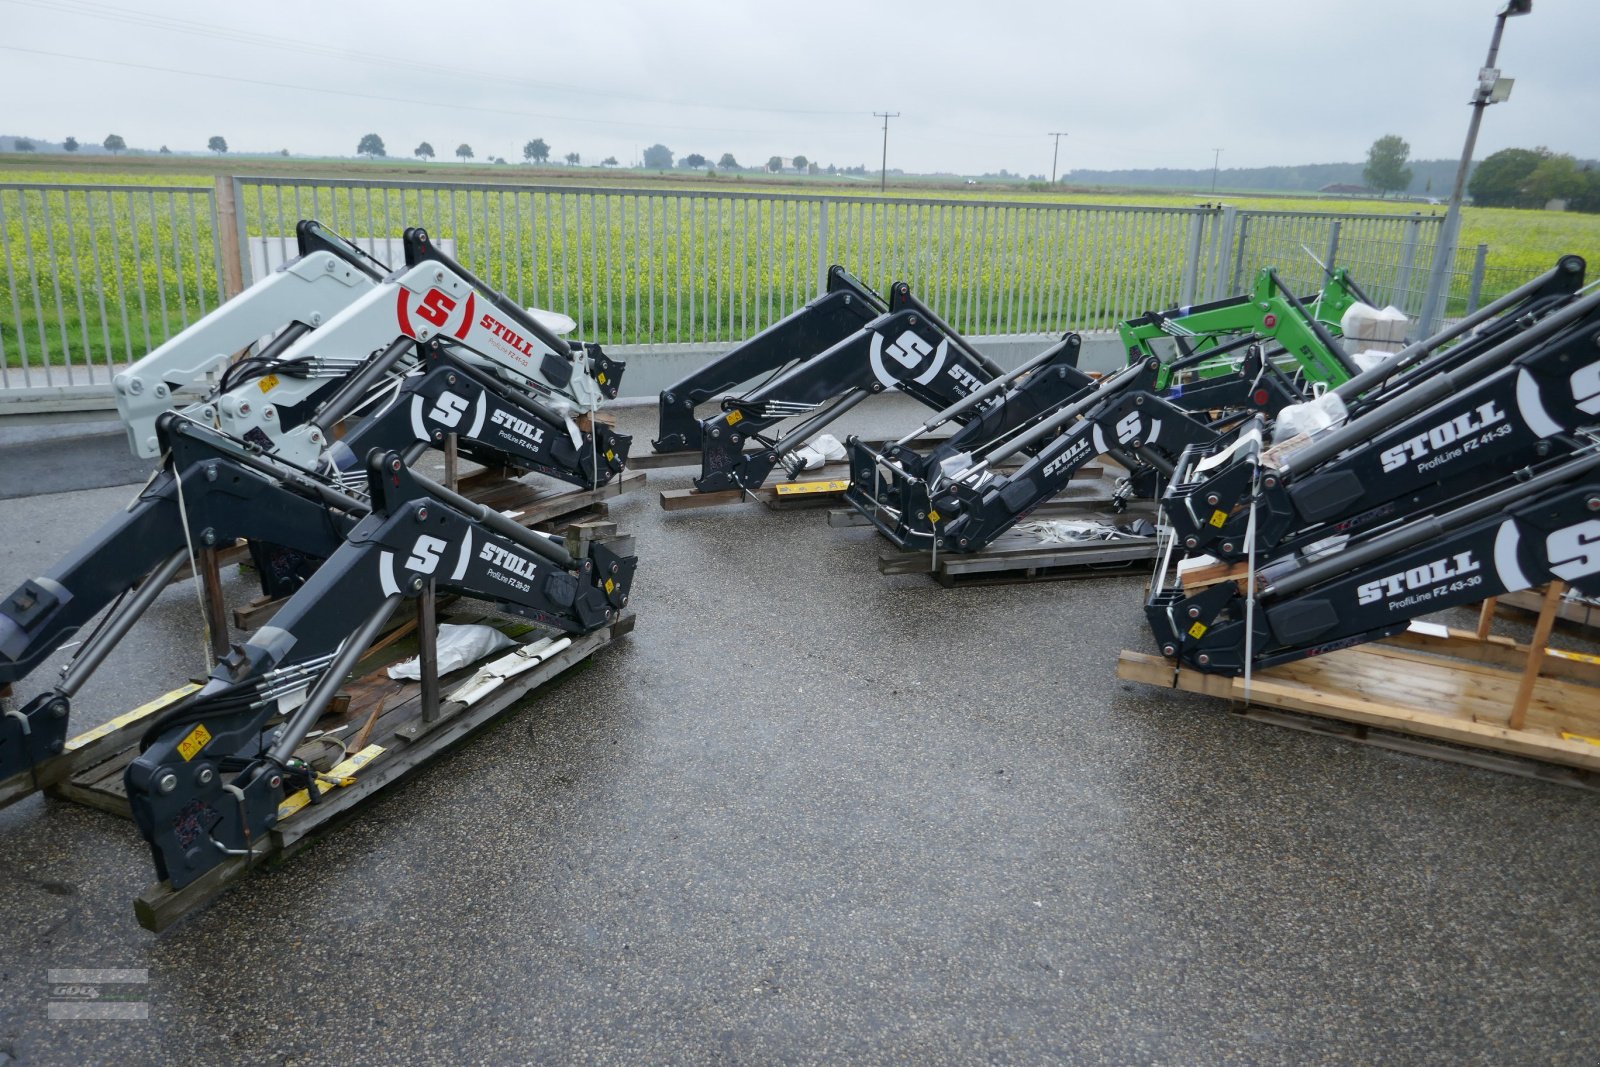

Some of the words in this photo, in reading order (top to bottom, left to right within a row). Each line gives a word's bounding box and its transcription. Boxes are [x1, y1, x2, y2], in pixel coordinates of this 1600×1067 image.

[415, 288, 457, 328] S
[479, 313, 534, 358] STOLL
[507, 350, 516, 359] FZ
[885, 330, 934, 369] S
[428, 390, 470, 428] S
[491, 408, 545, 444] STOLL
[518, 439, 527, 447] FZ
[1380, 400, 1506, 474] STOLL
[1417, 448, 1462, 474] ProfiLine
[1462, 437, 1480, 453] FZ
[1480, 423, 1513, 444] 41-33
[1042, 437, 1089, 478] STOLL
[404, 534, 448, 575] S
[479, 541, 538, 581] STOLL
[486, 568, 509, 584] ProfiLine
[507, 577, 517, 587] FZ
[1357, 550, 1481, 606] STOLL
[1388, 591, 1432, 611] ProfiLine
[1432, 584, 1449, 597] FZ
[1449, 575, 1483, 592] 43-30
